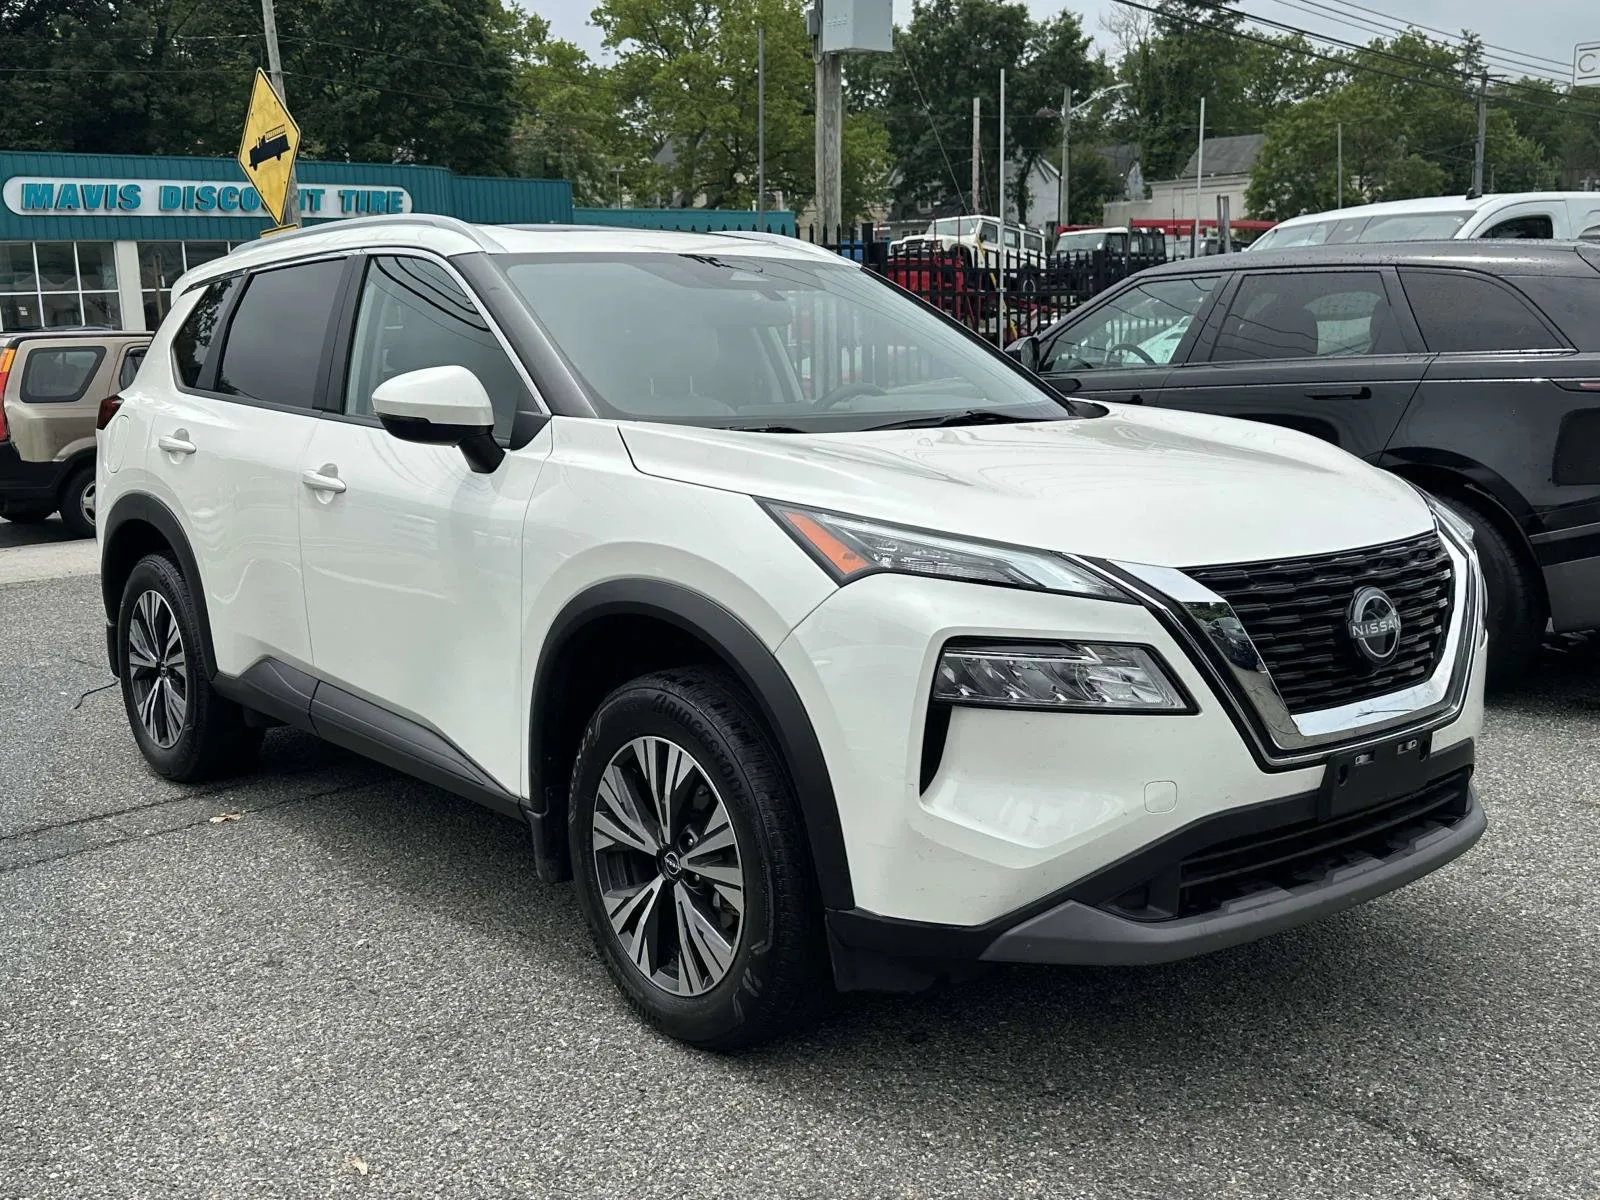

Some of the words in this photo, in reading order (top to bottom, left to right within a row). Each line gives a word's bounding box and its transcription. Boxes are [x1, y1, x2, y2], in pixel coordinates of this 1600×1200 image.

[21, 183, 142, 210] MAVIS
[159, 185, 325, 212] DISCOT
[338, 189, 404, 214] TIRE
[1352, 617, 1401, 636] NISSAN
